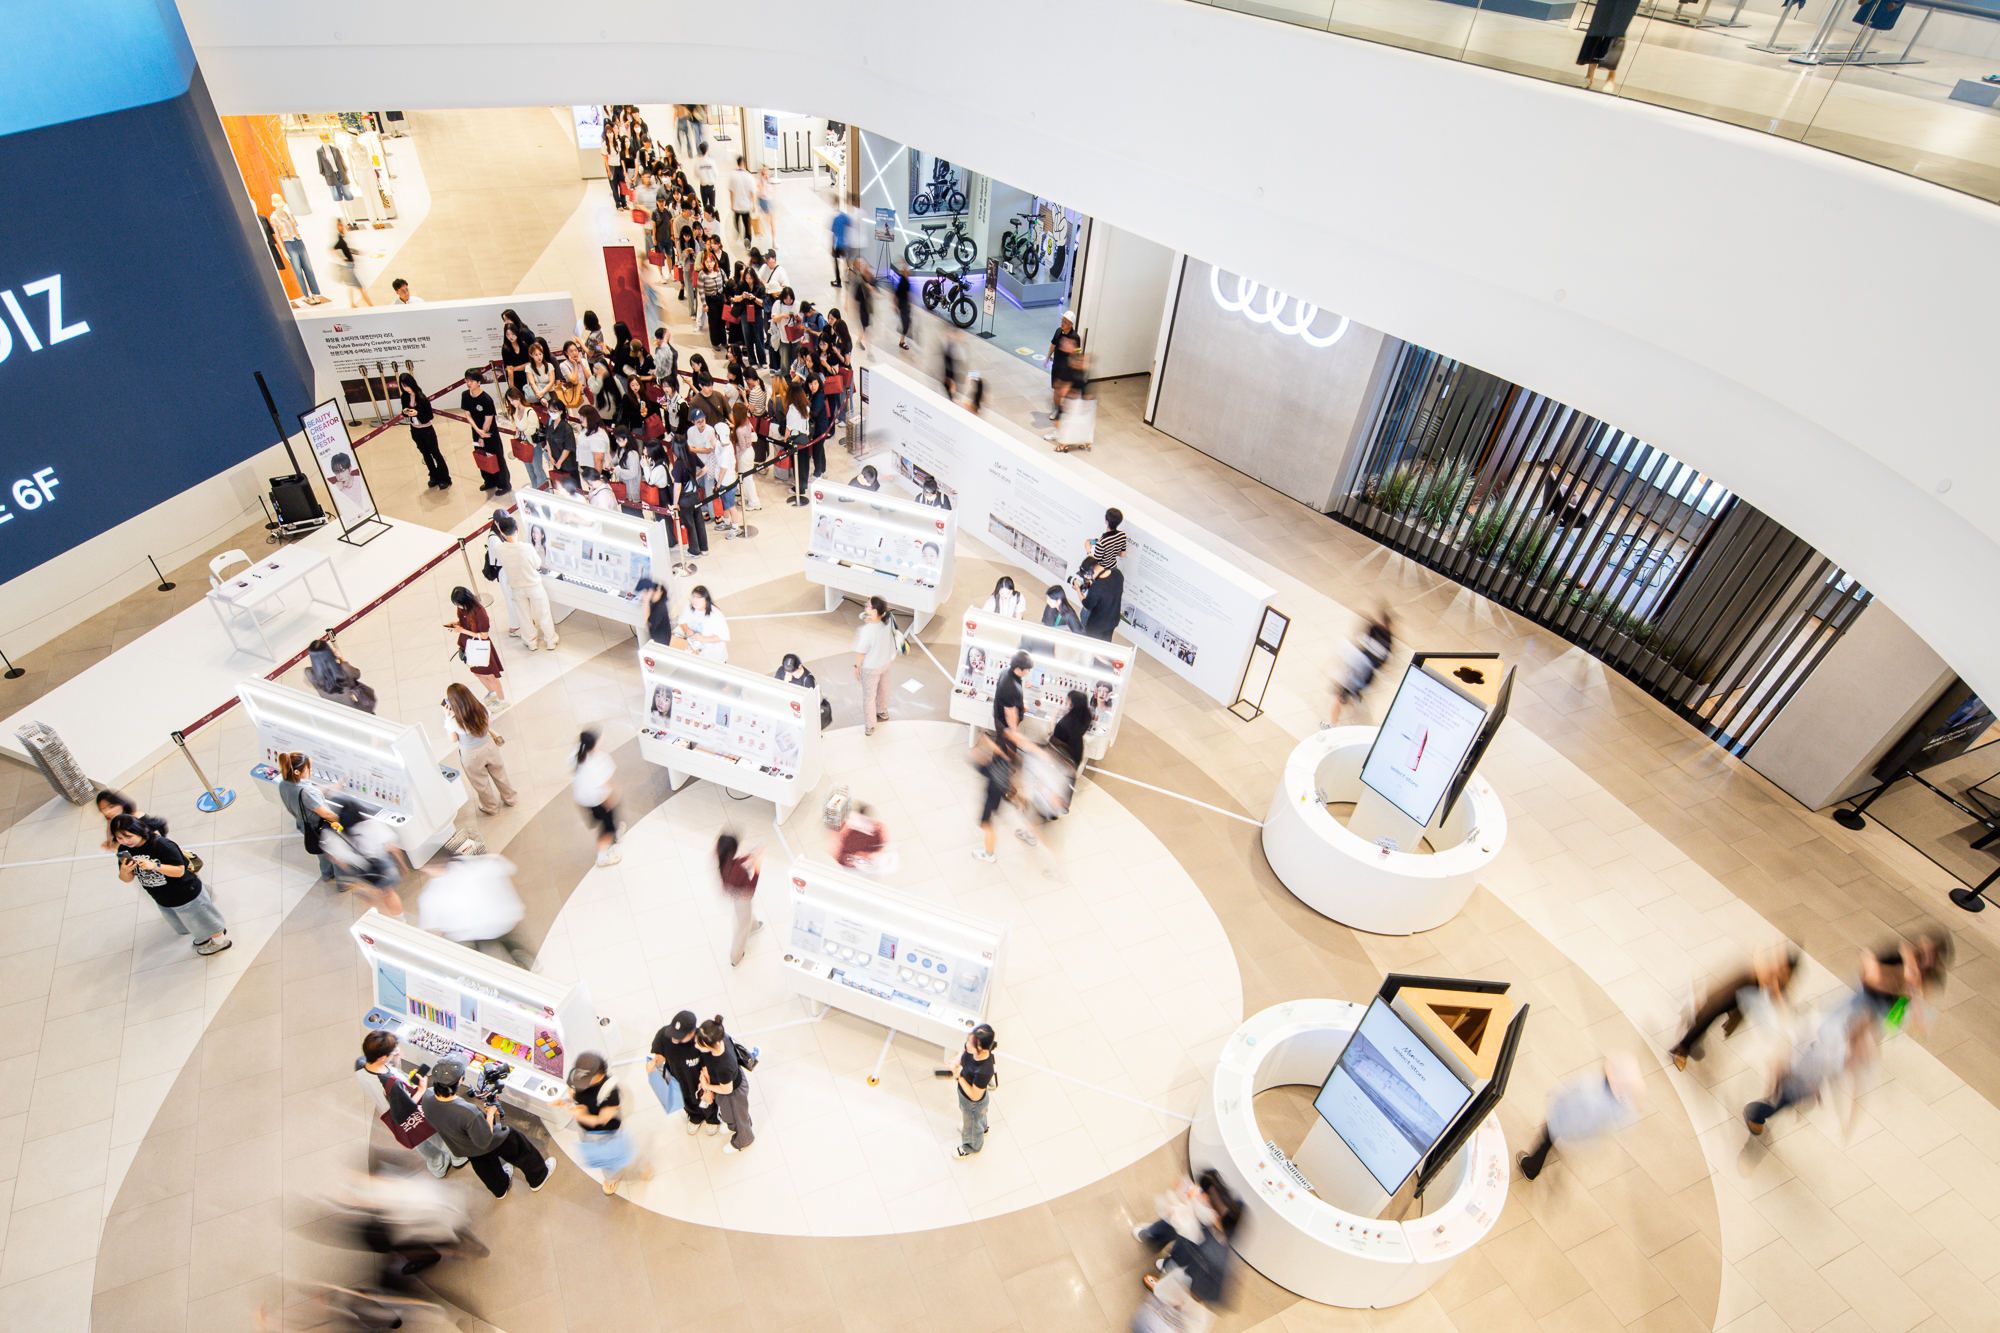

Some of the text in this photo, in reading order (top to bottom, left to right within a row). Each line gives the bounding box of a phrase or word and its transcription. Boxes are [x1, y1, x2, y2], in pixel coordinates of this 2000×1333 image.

[0, 274, 91, 363] IZ
[307, 411, 330, 428] BEAUTY
[310, 416, 340, 435] CREATOR
[312, 432, 326, 443] FAN
[316, 436, 335, 450] FESTA
[12, 466, 60, 510] 6F
[1390, 765, 1419, 788] select store
[1393, 1046, 1426, 1082] select store
[1266, 1142, 1311, 1190] Hello Summer
